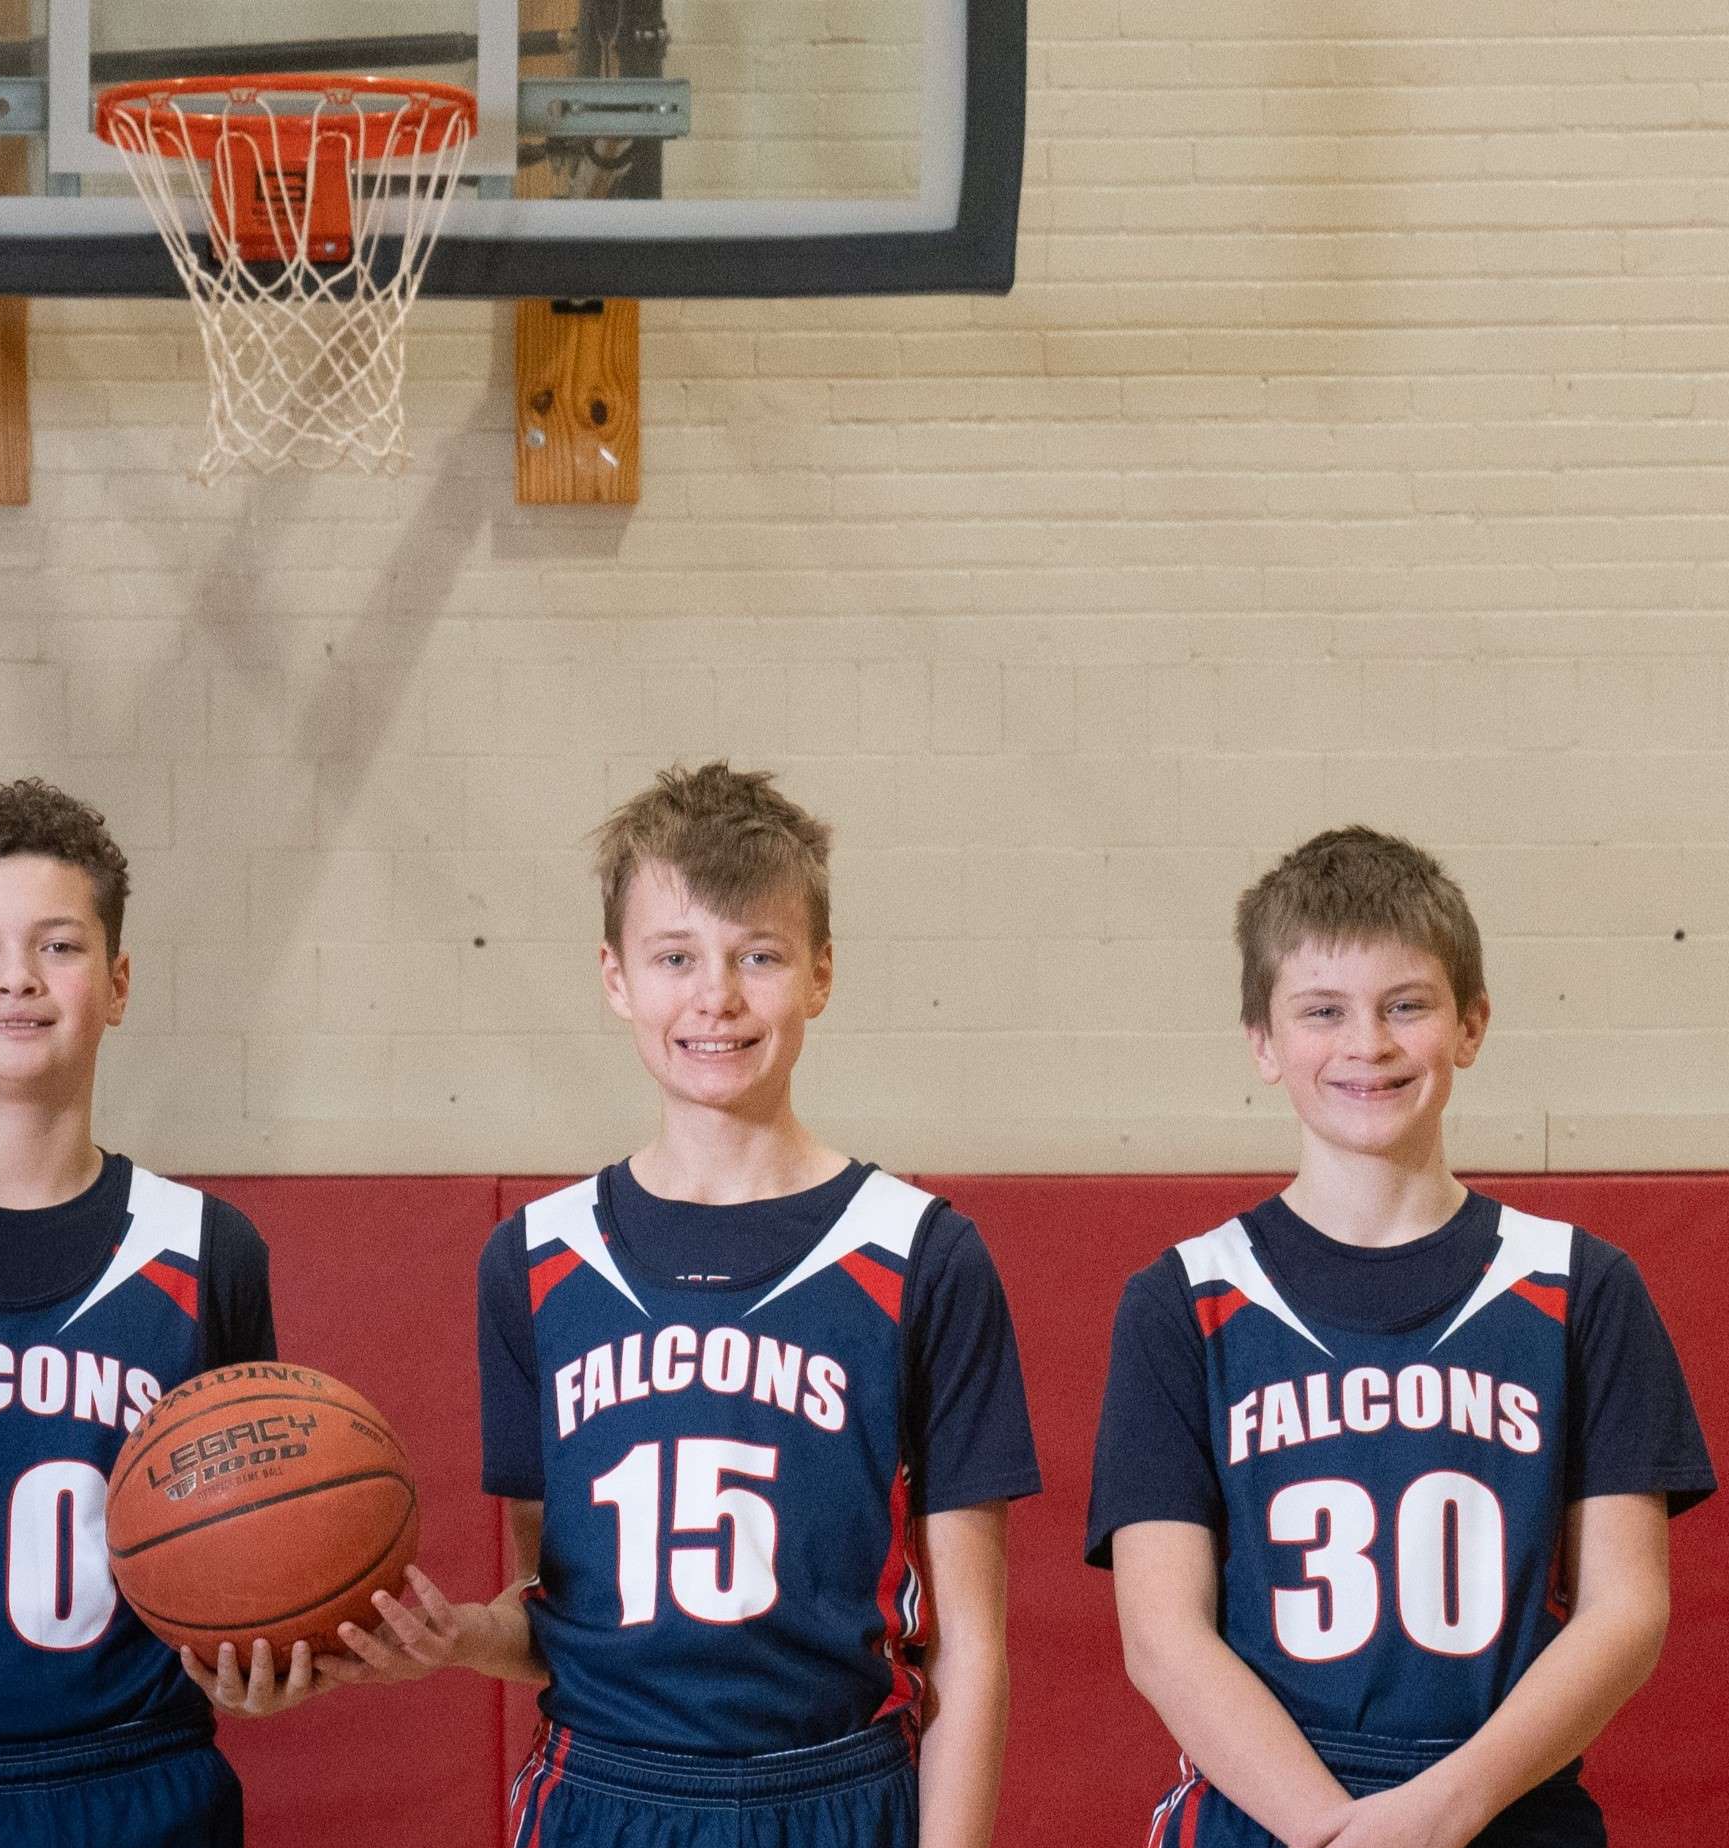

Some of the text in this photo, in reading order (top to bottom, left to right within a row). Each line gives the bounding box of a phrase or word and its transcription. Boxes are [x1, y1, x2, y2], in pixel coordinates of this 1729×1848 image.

[554, 1323, 848, 1441] FALCONS
[1227, 1362, 1543, 1467] FALCONS
[146, 1413, 318, 1490] LEGACY
[202, 1443, 308, 1484] 1000
[591, 1436, 781, 1629] 15
[1266, 1468, 1508, 1665] 30
